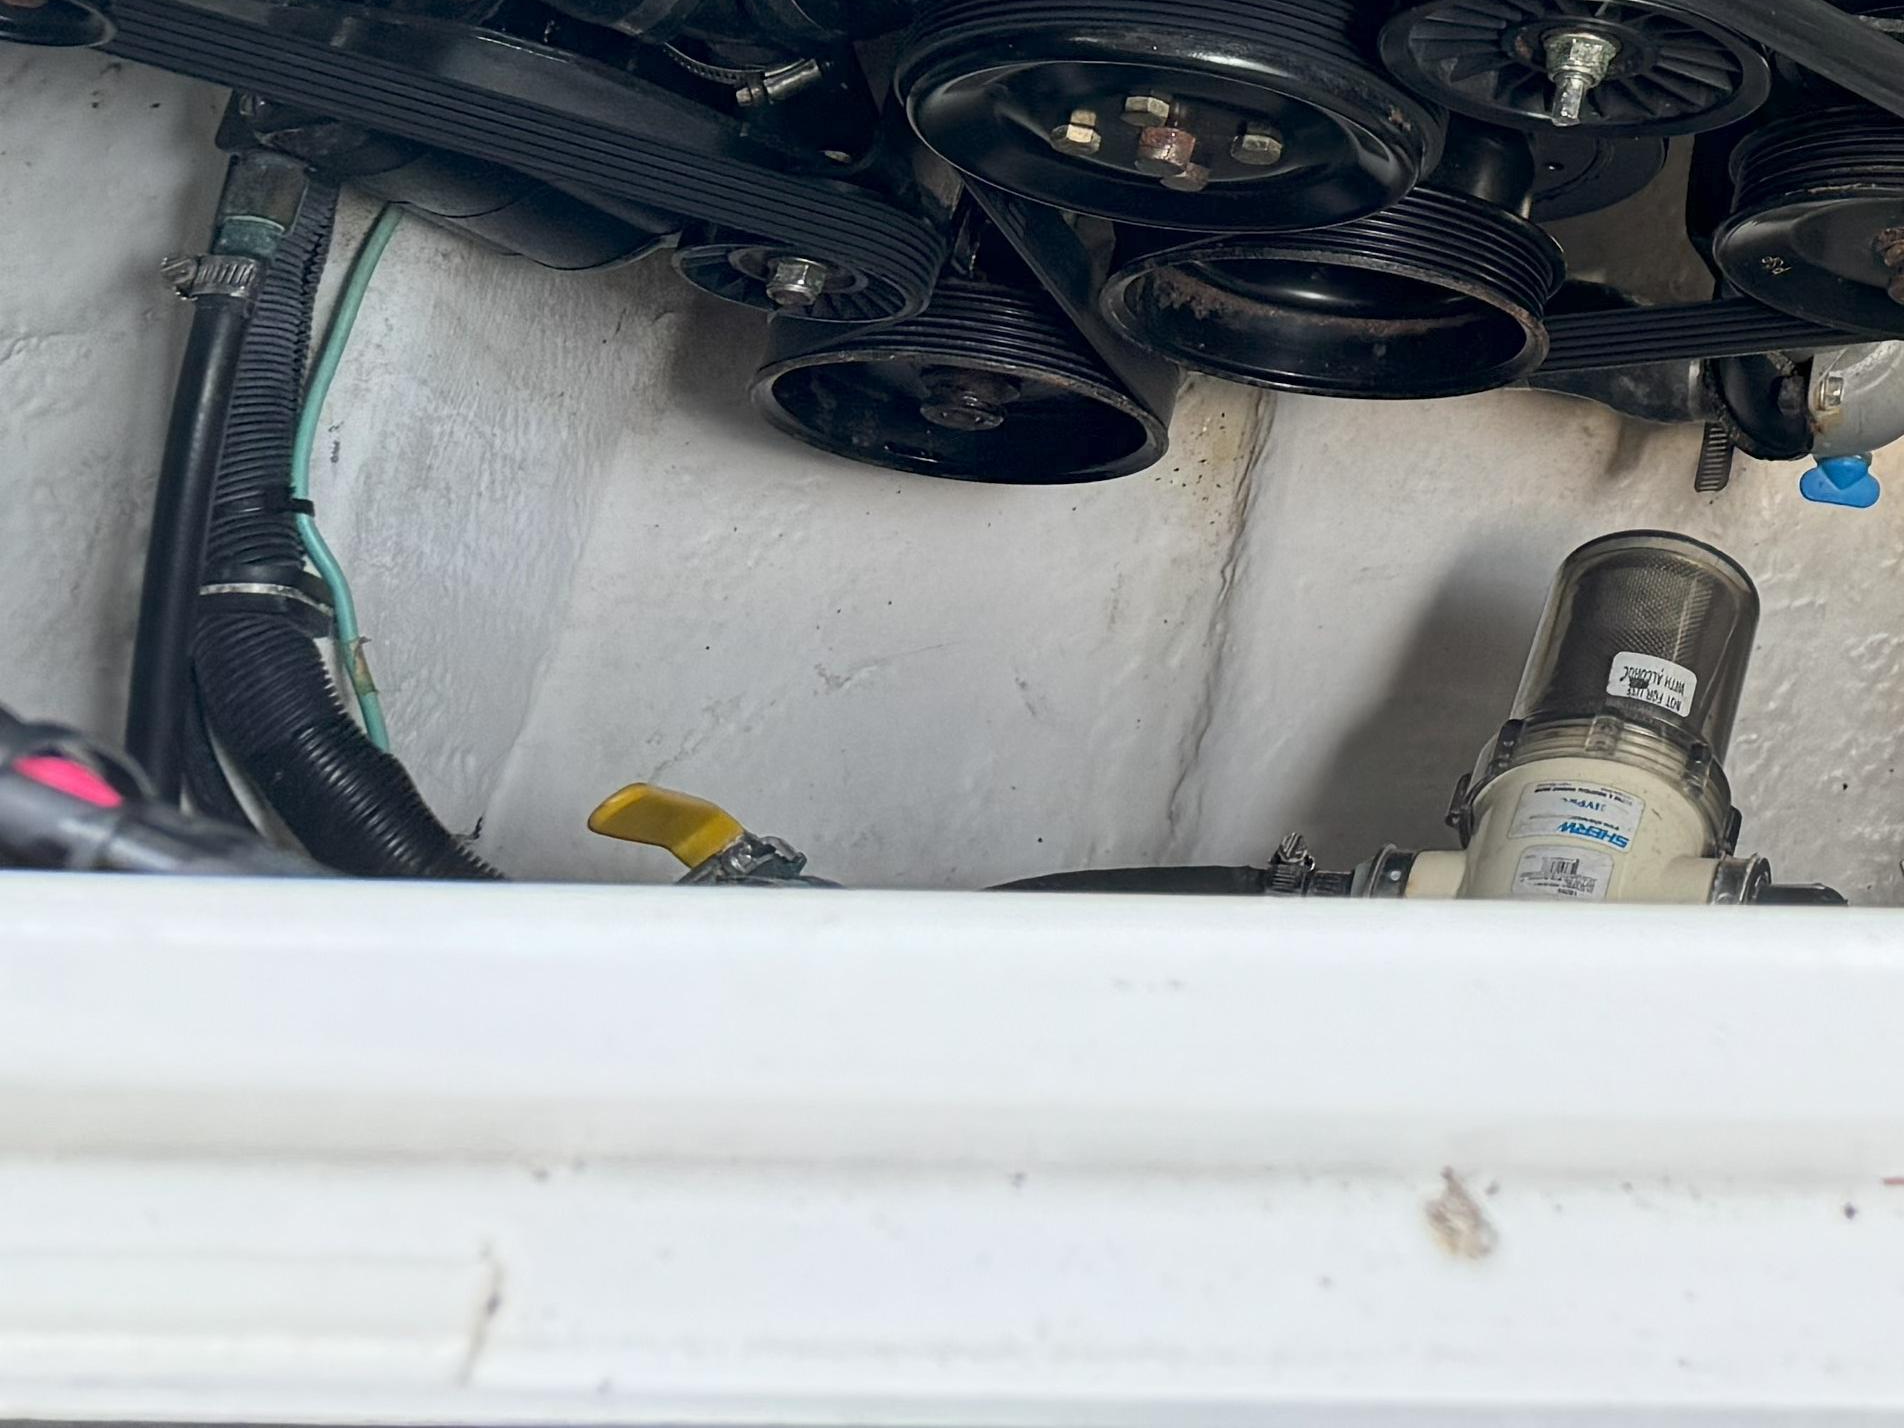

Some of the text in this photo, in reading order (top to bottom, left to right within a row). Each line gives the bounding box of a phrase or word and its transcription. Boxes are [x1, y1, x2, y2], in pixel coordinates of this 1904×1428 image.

[1664, 676, 1686, 696] WITH
[1645, 690, 1664, 708] FOR
[1664, 693, 1682, 712] NOT
